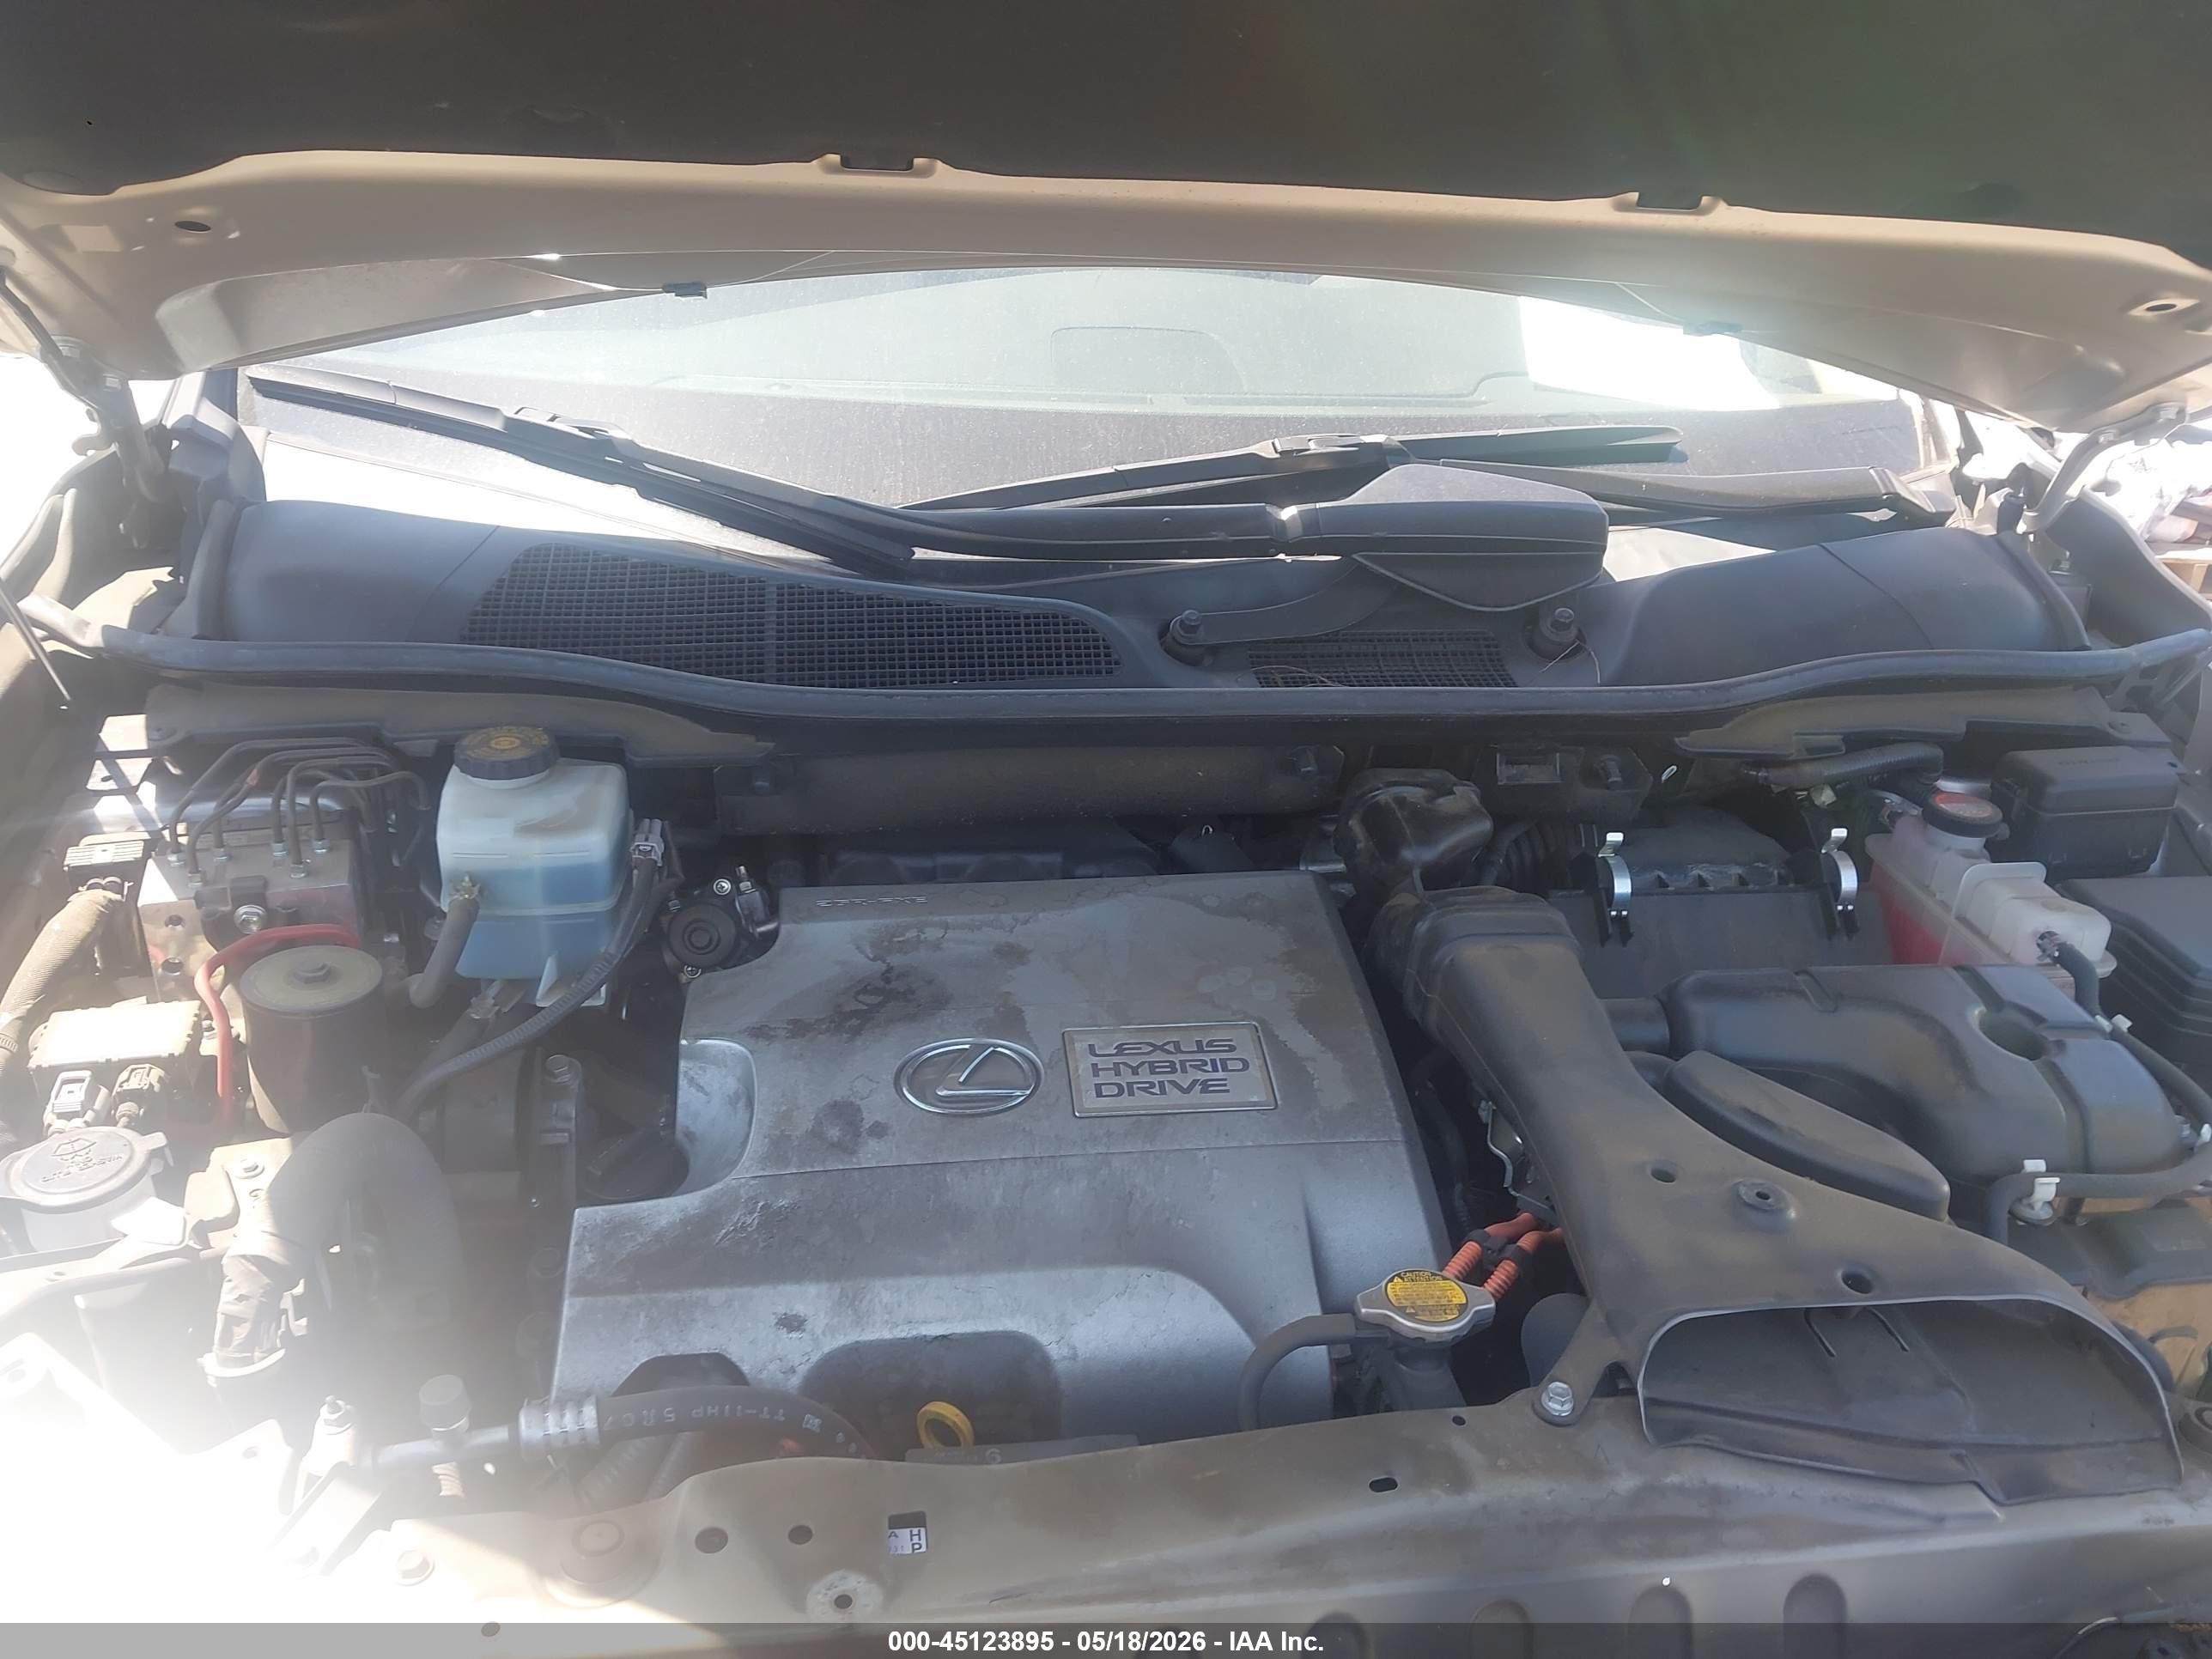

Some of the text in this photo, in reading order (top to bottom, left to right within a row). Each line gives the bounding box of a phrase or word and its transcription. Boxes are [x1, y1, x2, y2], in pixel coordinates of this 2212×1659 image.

[1088, 1038, 1237, 1058] LEXUS
[1091, 1057, 1250, 1078] HYBRID
[1094, 1078, 1231, 1098] DRIVE
